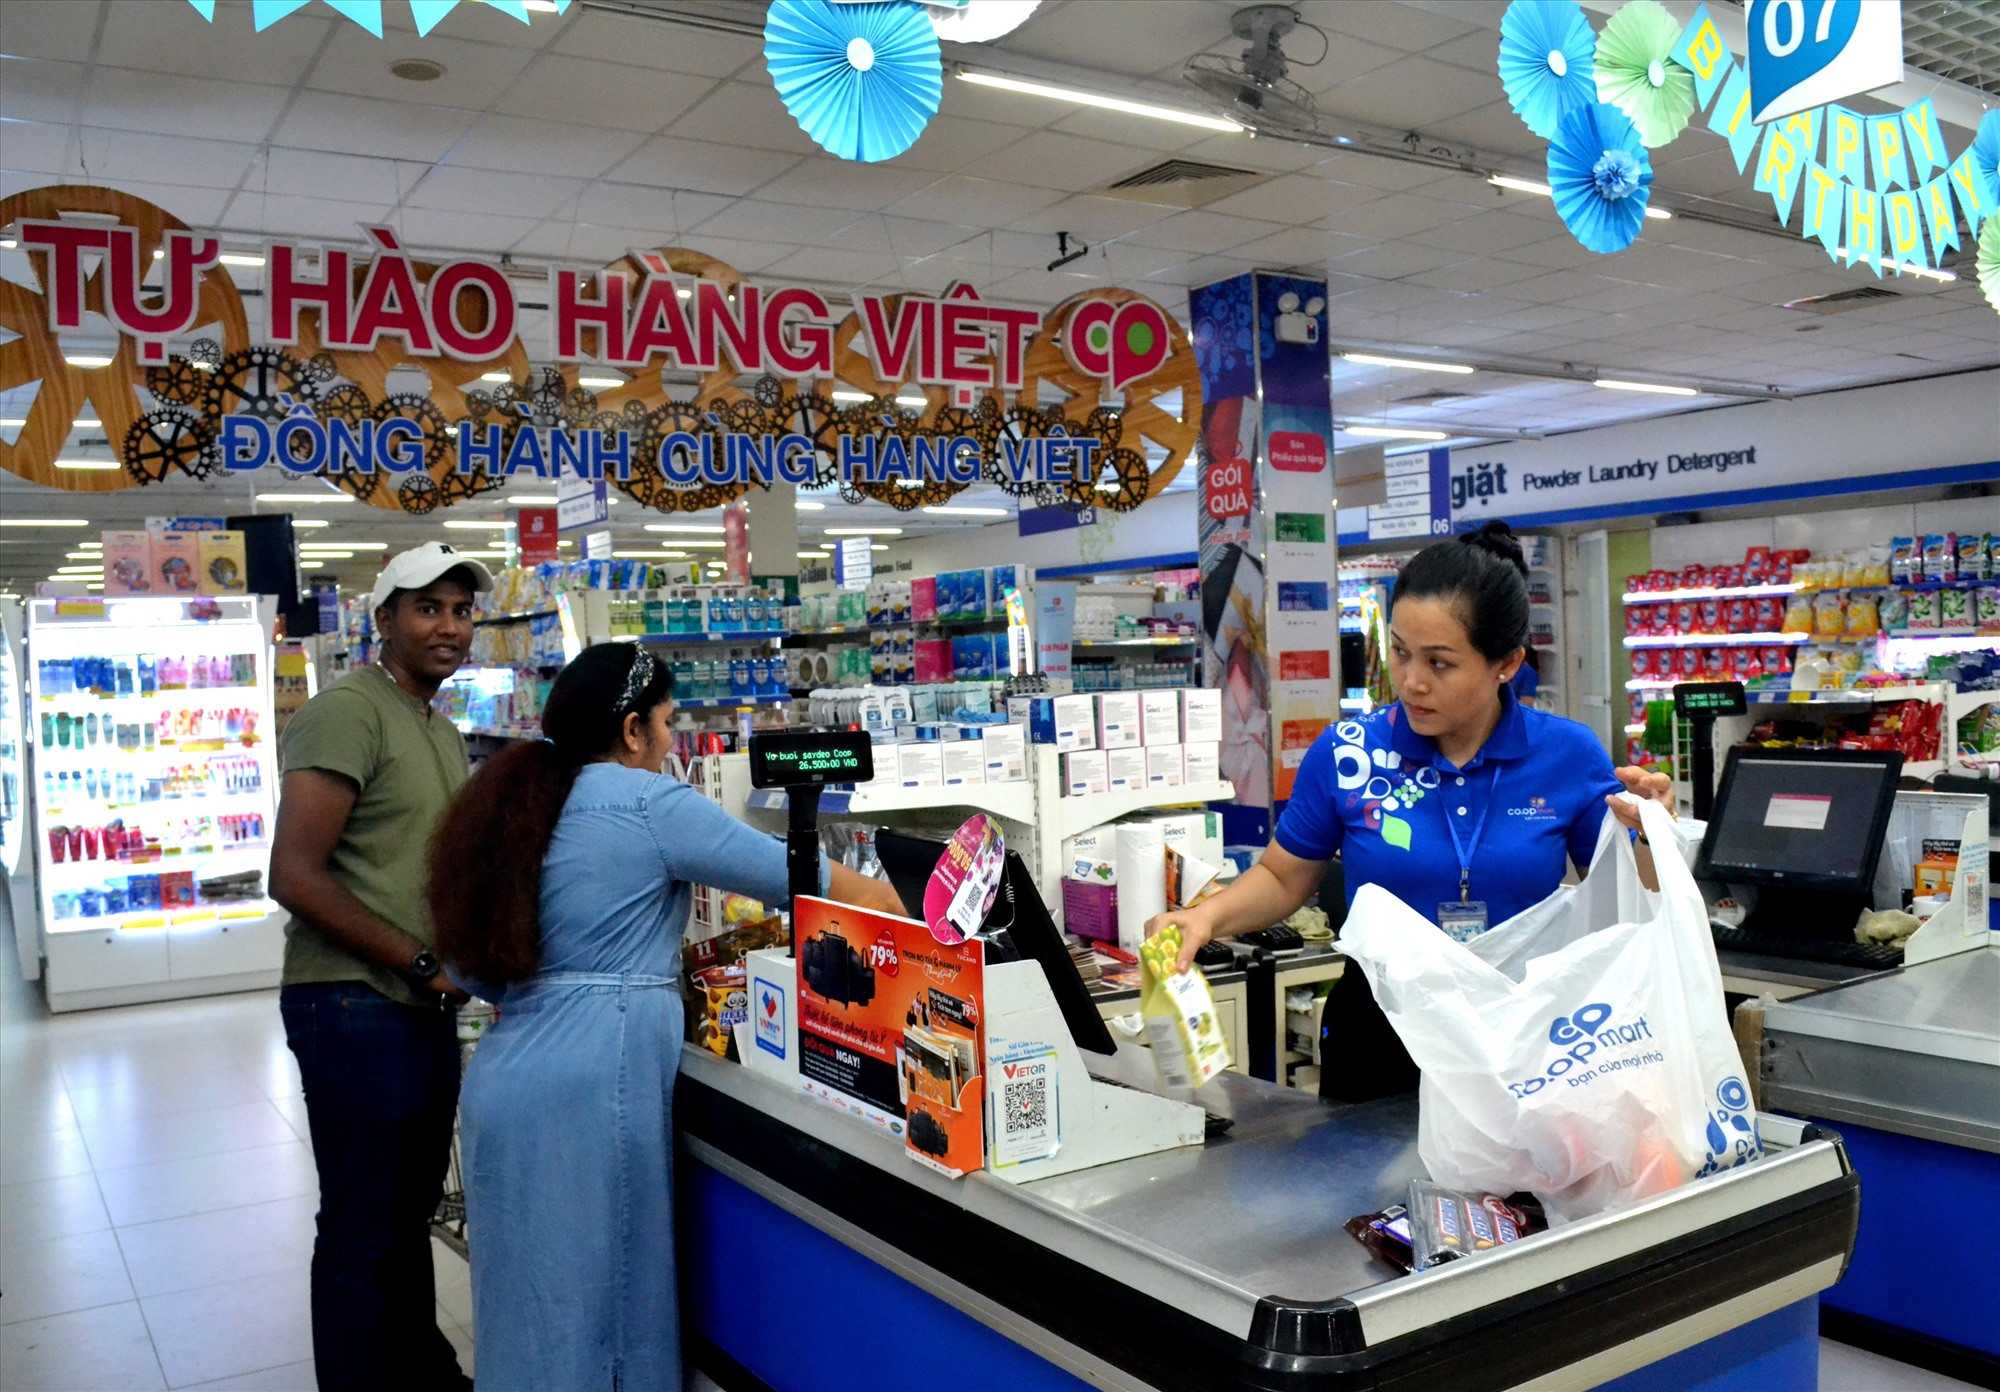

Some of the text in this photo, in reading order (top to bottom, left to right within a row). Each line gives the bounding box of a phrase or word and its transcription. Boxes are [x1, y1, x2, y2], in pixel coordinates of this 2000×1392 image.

[1763, 0, 1837, 58] 07
[1785, 103, 1934, 178] APPY
[18, 222, 1041, 406] TỰ HÀO HÀNG VIỆT
[219, 393, 1099, 494] ĐỒNG HÀNH CÙNG HÀNG VIỆT
[1210, 464, 1242, 488] GÓI
[1451, 446, 1756, 509] giặt Powder Laundry Detergent
[1210, 489, 1249, 514] QUÀ
[1433, 519, 1449, 534] 06
[843, 757, 858, 767] VND
[1074, 836, 1097, 847] Select
[1164, 826, 1186, 837] Select
[696, 941, 711, 956] 11
[870, 944, 898, 967] 79%
[956, 954, 977, 965] TUCANO
[720, 1011, 748, 1019] HELL
[962, 1003, 977, 1017] 79%
[835, 1049, 861, 1069] NGAY!
[1567, 1050, 1664, 1088] bạn của mọi nhà
[1003, 1063, 1046, 1080] VIETQR
